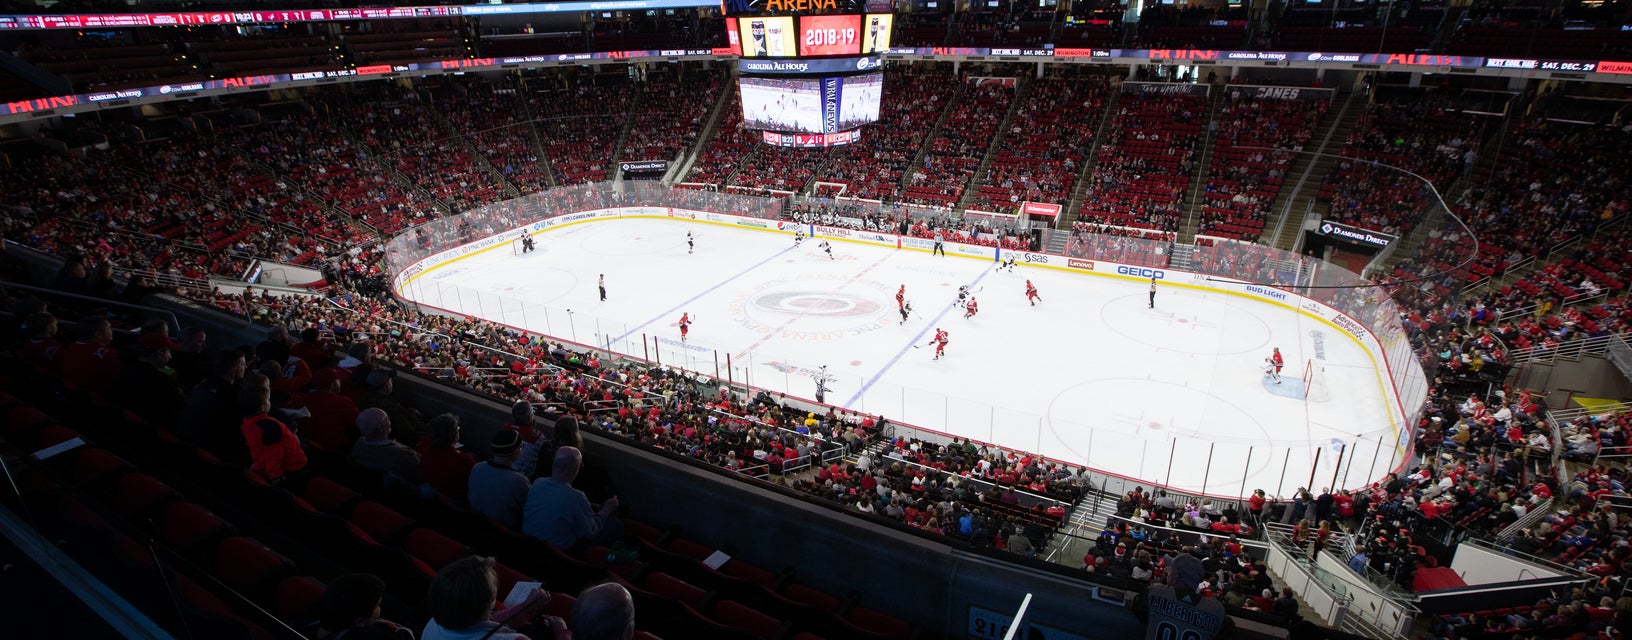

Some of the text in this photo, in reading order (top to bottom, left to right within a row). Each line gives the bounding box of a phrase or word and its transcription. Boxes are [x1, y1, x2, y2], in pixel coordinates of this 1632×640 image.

[806, 28, 855, 46] 2018-19
[773, 62, 786, 70] ALE
[786, 63, 808, 72] HOUSE
[88, 93, 116, 102] CAROLINA
[1256, 87, 1300, 100] CANES
[826, 104, 836, 132] NEWS
[572, 212, 596, 221] CAROLINAS
[546, 218, 556, 227] NC
[816, 226, 836, 234] BULLY
[1333, 226, 1390, 246] DIAMONDS DIRECT
[1032, 254, 1048, 263] sas
[1070, 260, 1092, 269] Lenovo
[1117, 266, 1165, 280] GEICO
[1246, 285, 1287, 300] BUD LIGHT
[1337, 314, 1362, 332] Advance
